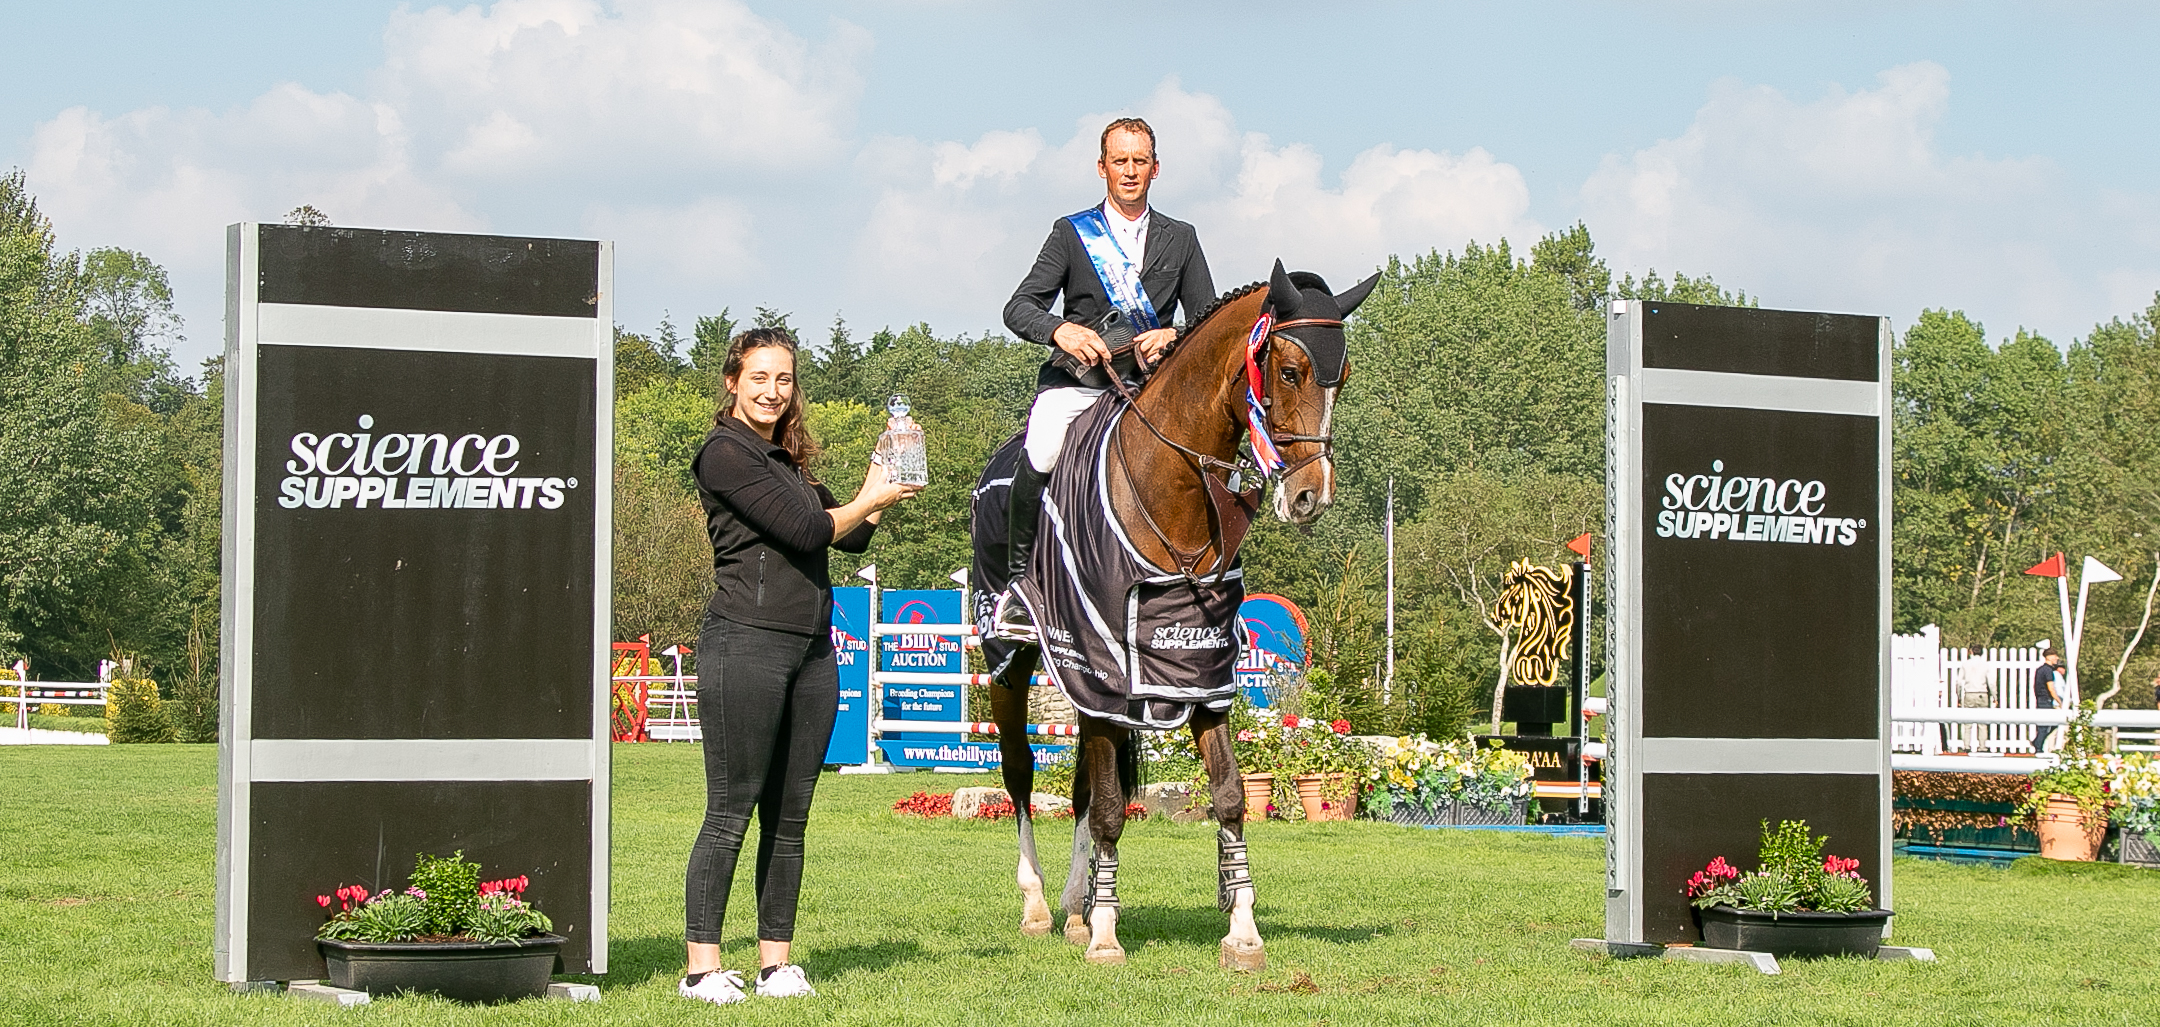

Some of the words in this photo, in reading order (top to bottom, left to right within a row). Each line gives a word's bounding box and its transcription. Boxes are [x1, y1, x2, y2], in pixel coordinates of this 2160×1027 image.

[286, 414, 520, 476] science
[1662, 459, 1826, 516] science
[1153, 622, 1221, 640] science
[847, 641, 867, 651] STUD
[883, 642, 898, 652] THE
[901, 634, 938, 653] Billy
[939, 642, 959, 652] STUD
[891, 653, 947, 667] AUCTION
[889, 688, 918, 699] Breeding
[919, 688, 955, 700] Champions
[901, 701, 912, 711] for
[912, 701, 923, 711] the
[923, 701, 943, 711] future
